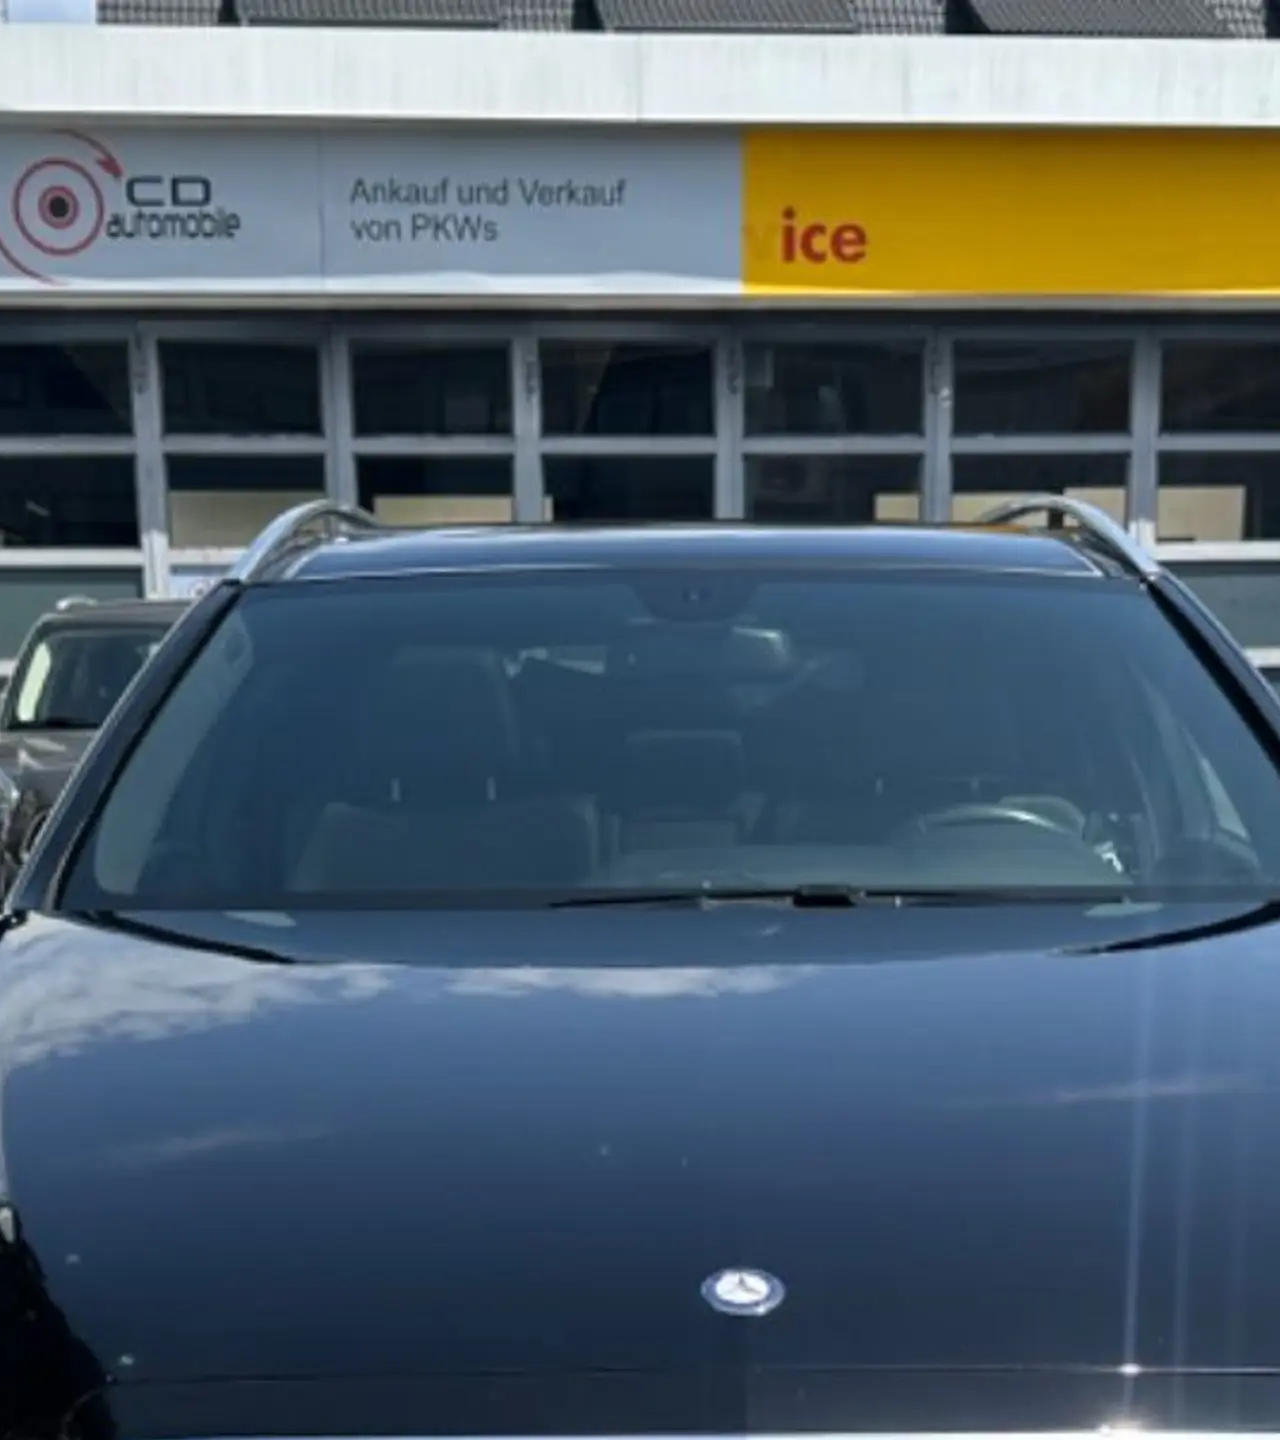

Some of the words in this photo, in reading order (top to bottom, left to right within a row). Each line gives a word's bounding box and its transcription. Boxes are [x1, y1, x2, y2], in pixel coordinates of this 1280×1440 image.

[125, 175, 212, 207] CD
[349, 177, 448, 206] Ankauf
[456, 178, 510, 206] und
[519, 178, 627, 207] Verkauf
[106, 207, 240, 239] automobile
[349, 219, 402, 242] von
[410, 215, 499, 242] PKWs
